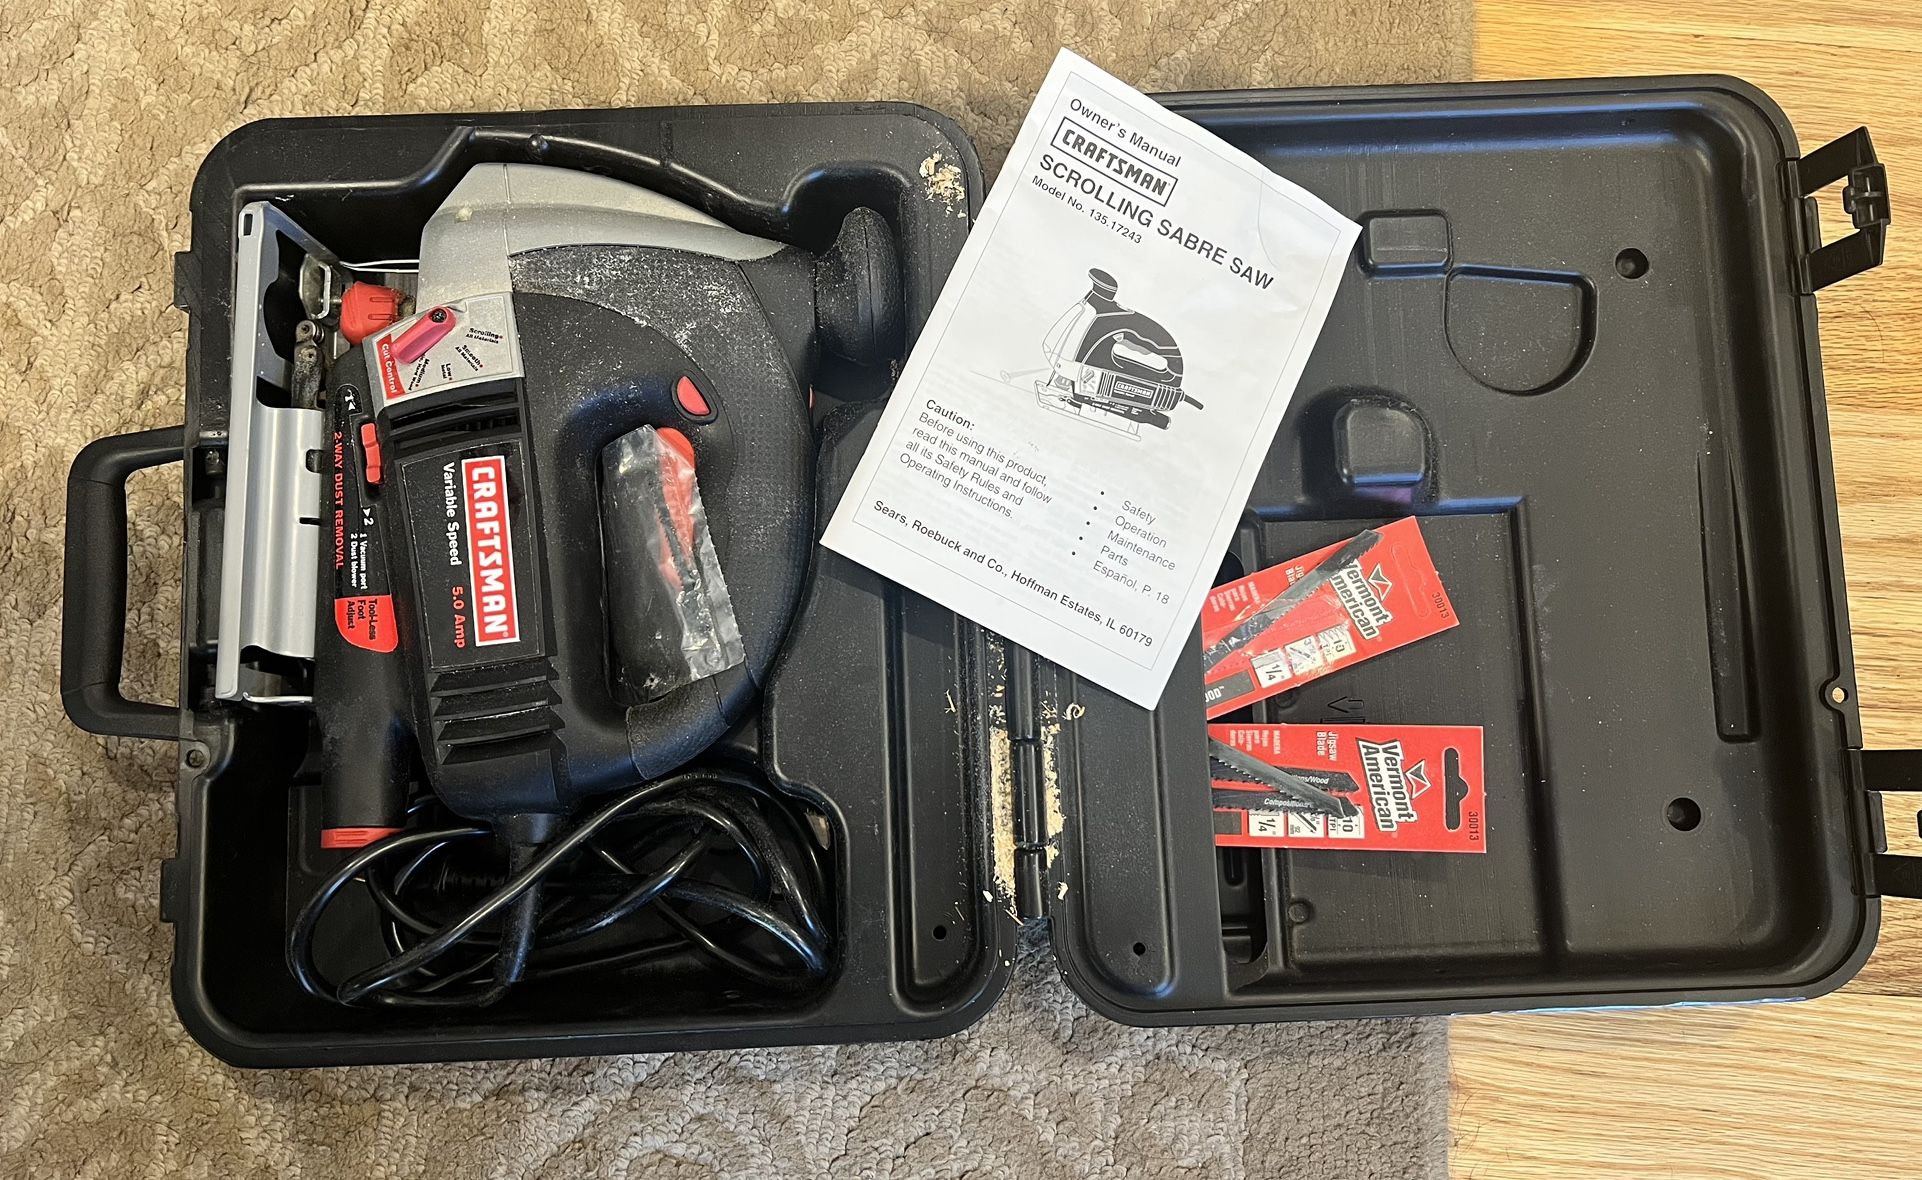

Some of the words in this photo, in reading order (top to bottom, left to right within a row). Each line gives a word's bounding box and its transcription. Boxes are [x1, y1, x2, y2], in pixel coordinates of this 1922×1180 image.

[1070, 98, 1126, 138] Owner's
[1129, 132, 1181, 167] Manual
[1062, 129, 1167, 196] CRAFTSMAN
[1031, 175, 1066, 200] Model
[1067, 195, 1084, 212] No.
[1089, 209, 1141, 243] 135.17243
[1039, 154, 1153, 227] SCROLLING
[1157, 219, 1227, 265] SABRE
[1229, 257, 1274, 289] SAW
[469, 327, 499, 339] Scrolling
[382, 343, 390, 360] Cut
[462, 344, 481, 366] Smooth
[385, 361, 397, 393] Control
[417, 358, 430, 384] Medium
[926, 399, 974, 430] Caution:
[334, 431, 343, 469] 2-WAY
[912, 427, 938, 444] read
[939, 439, 957, 455] this
[959, 452, 999, 476] manual
[999, 472, 1021, 487] and
[1021, 481, 1052, 503] follow
[918, 411, 954, 436] Before
[956, 433, 984, 454] using
[986, 447, 1005, 463] this
[1005, 459, 1046, 487] product,
[334, 473, 343, 506] DUST
[443, 461, 458, 518] Variable
[900, 452, 951, 488] Operating
[953, 479, 1012, 518] Instructions.
[905, 441, 920, 452] all
[920, 446, 933, 459] its
[934, 454, 969, 479] Safety
[970, 472, 1000, 494] Rules
[1001, 490, 1024, 505] and
[363, 517, 374, 526] 2
[1122, 500, 1156, 525] Safety
[335, 509, 344, 570] REMOVAL
[447, 521, 462, 566] Speed
[1115, 515, 1166, 547] Operation
[350, 541, 358, 559] Dust
[471, 466, 509, 634] CRAFTSMAN
[1100, 545, 1128, 566] Parts
[1107, 530, 1175, 570] Maintenance
[360, 575, 368, 590] port
[874, 500, 907, 527] Sears,
[911, 519, 962, 552] Roebuck
[962, 548, 986, 563] and
[987, 558, 1007, 577] Co.,
[1010, 570, 1057, 600] Hoffman
[1059, 594, 1102, 625] Estates,
[1105, 617, 1115, 630] IL
[1119, 624, 1152, 646] 60179
[1093, 560, 1137, 591] Español,
[1141, 584, 1151, 596] P.
[1156, 592, 1169, 604] 18
[347, 600, 356, 630] Adjust
[357, 599, 366, 620] Foot
[452, 586, 464, 610] 5.0
[1332, 575, 1377, 637] merican
[1432, 591, 1450, 619] 30013
[368, 599, 378, 641] Tool-Less
[454, 614, 466, 649] Amp
[1317, 731, 1328, 756] Blade
[1327, 731, 1339, 761] Jigsaw
[1362, 744, 1395, 829] American
[1381, 744, 1414, 819] Vermont
[1342, 816, 1353, 833] 10
[1468, 811, 1479, 841] 30013
